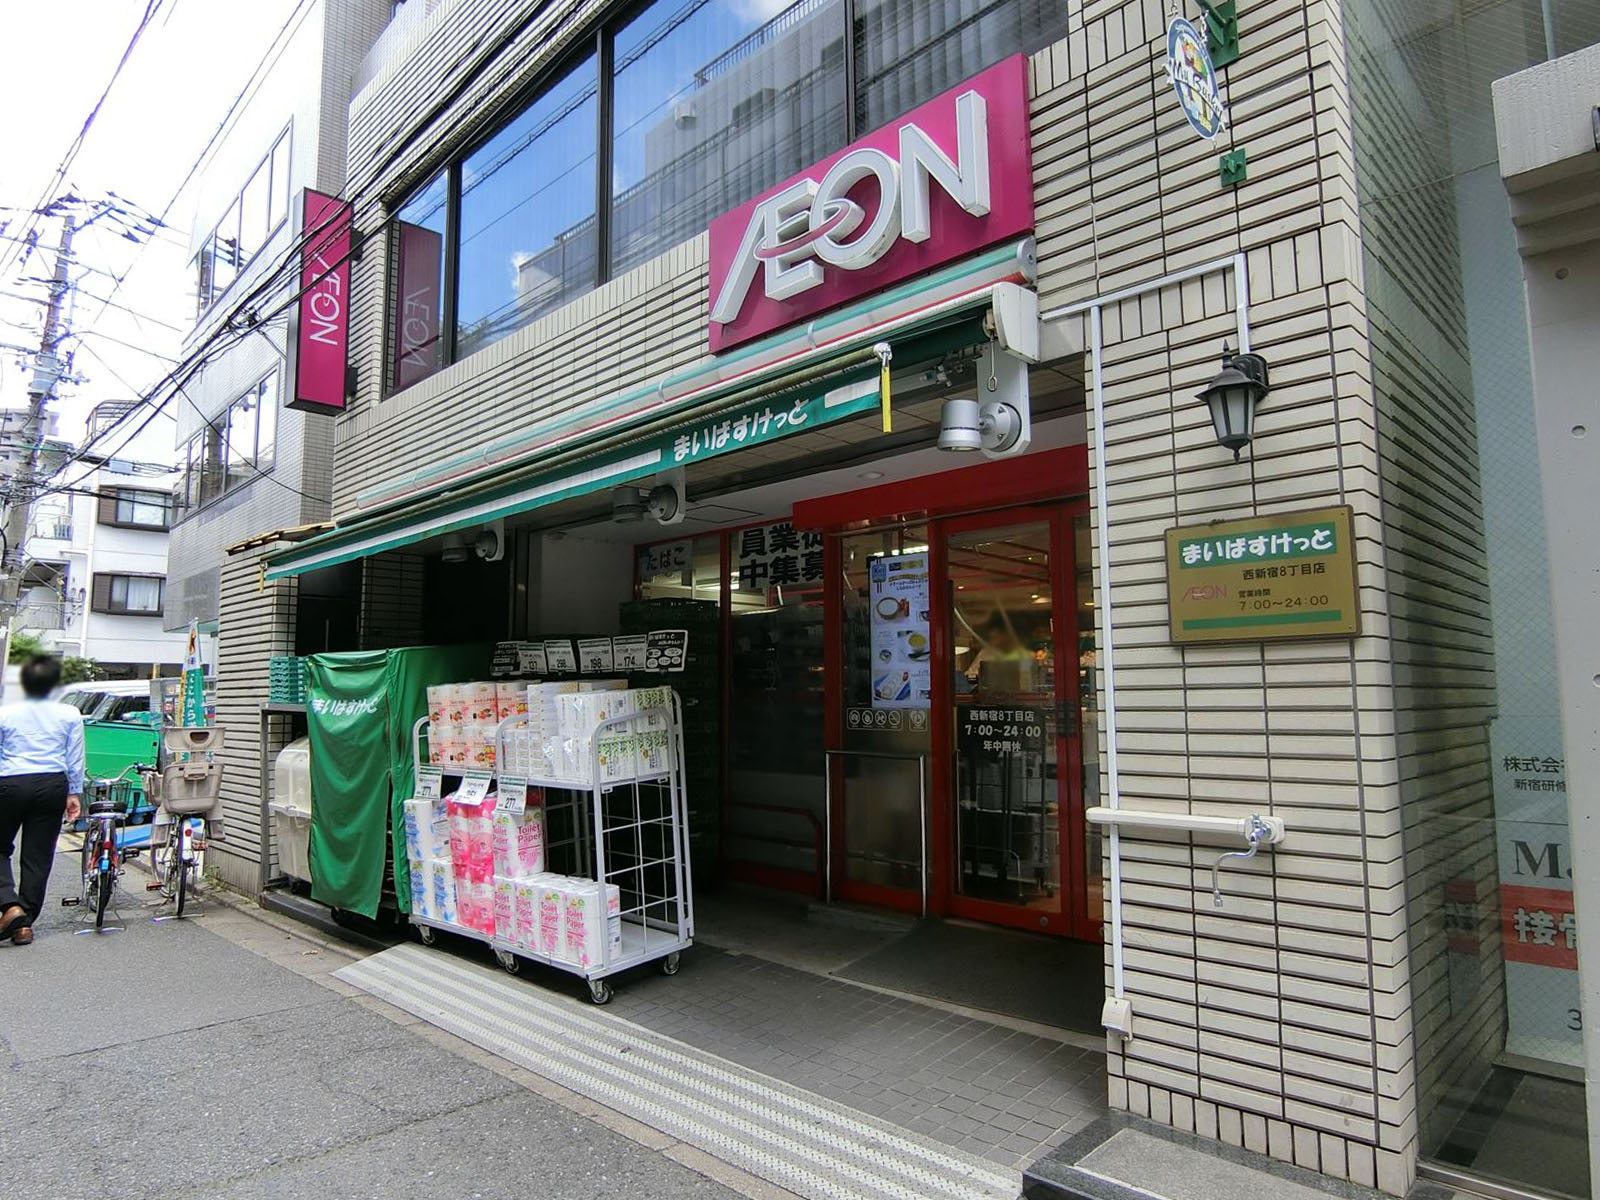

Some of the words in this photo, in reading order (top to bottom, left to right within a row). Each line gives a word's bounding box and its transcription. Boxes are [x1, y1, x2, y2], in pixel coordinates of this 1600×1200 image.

[673, 398, 810, 463] まいばすけっと
[1182, 528, 1334, 565] まいばすけっと
[646, 546, 686, 572] たばこ
[1242, 562, 1326, 581] 西新宿8丁目店
[969, 709, 1036, 722] 西新宿8丁目店
[983, 740, 1022, 752] 年中無休
[518, 823, 541, 836] Toilet
[517, 832, 542, 844] Paper
